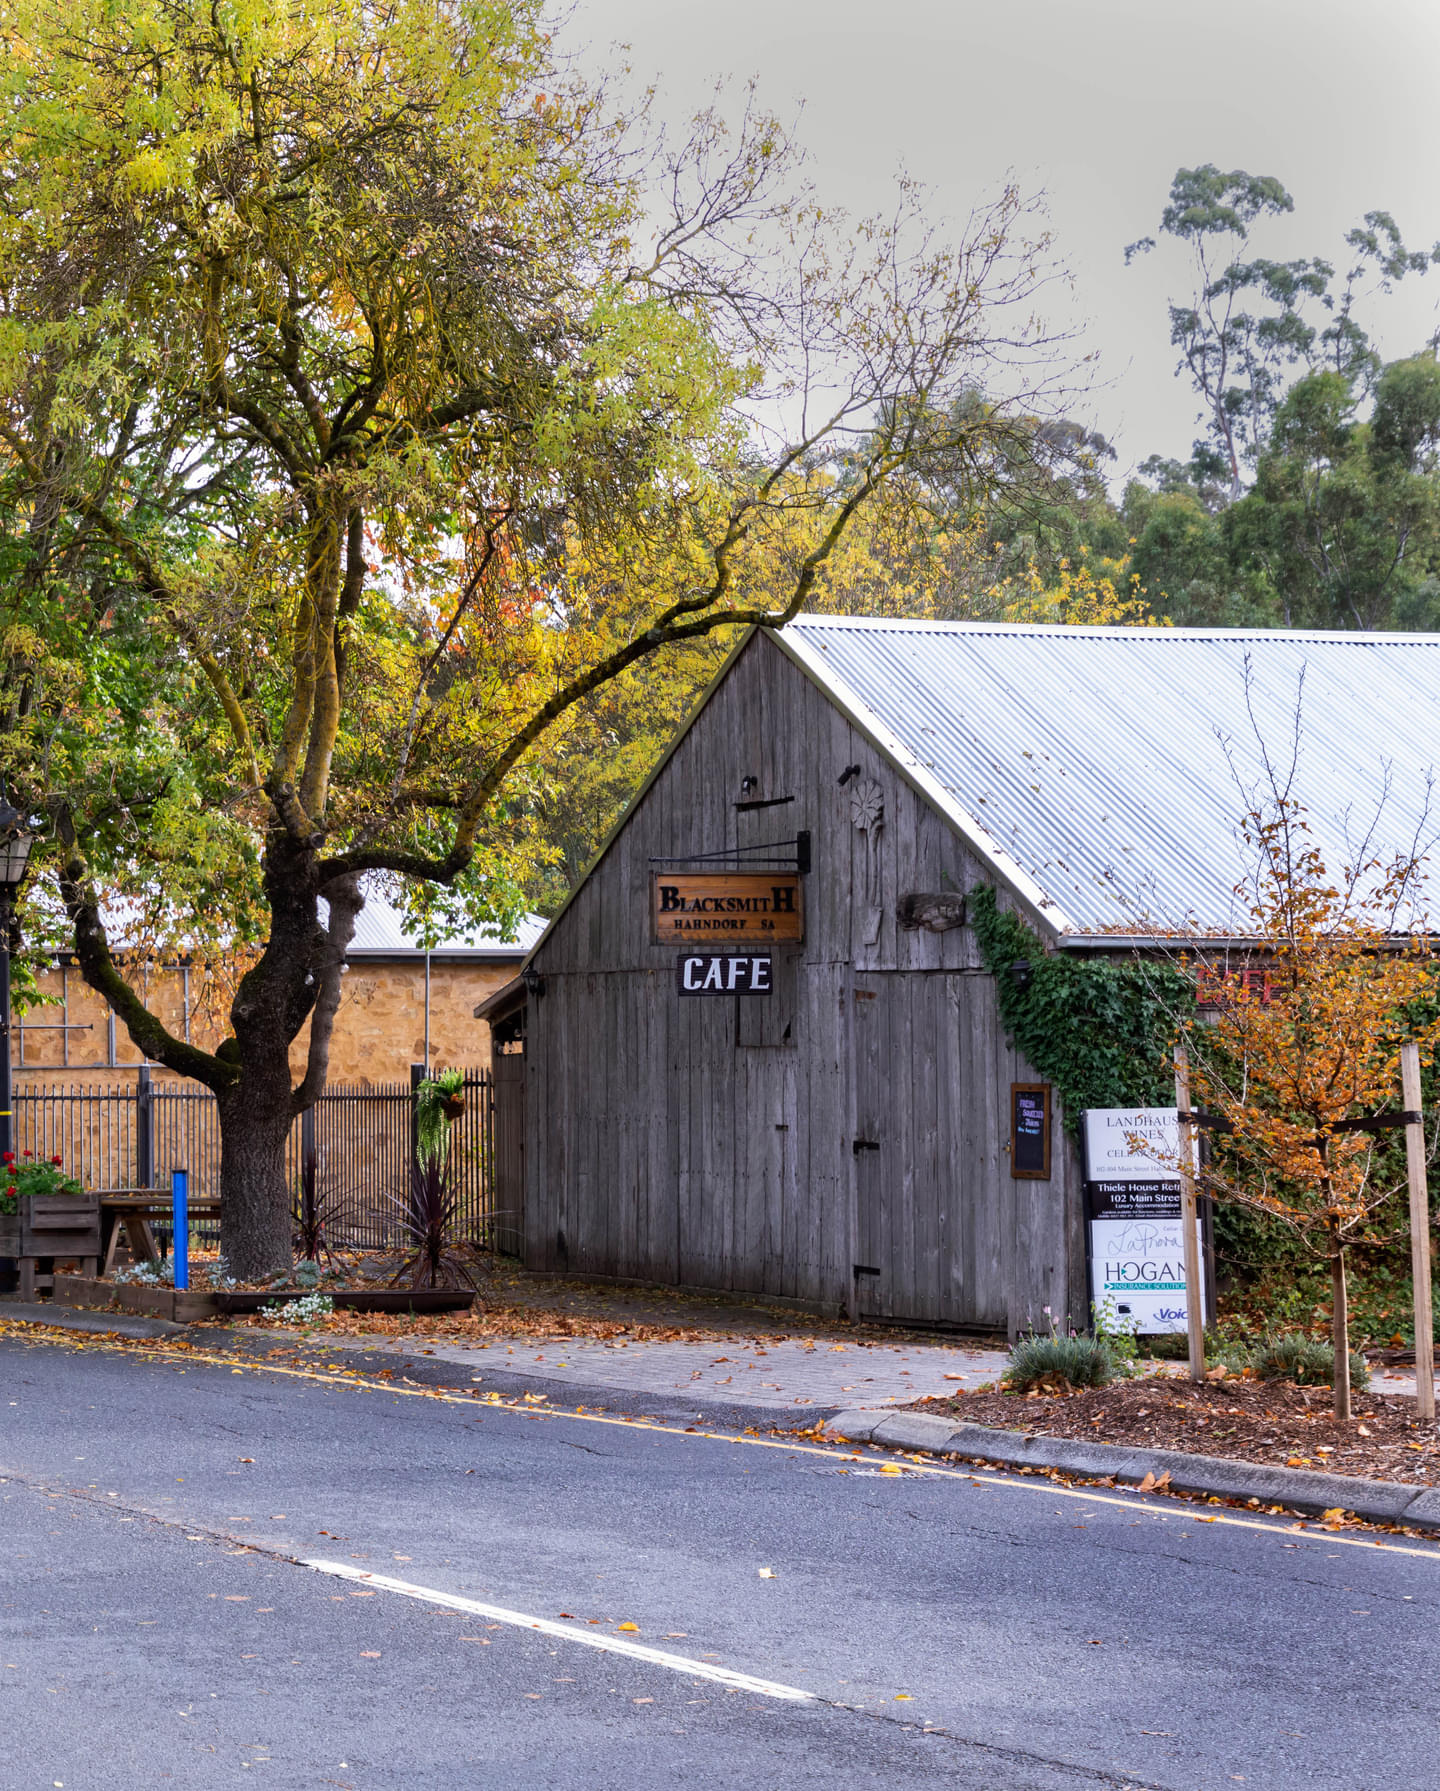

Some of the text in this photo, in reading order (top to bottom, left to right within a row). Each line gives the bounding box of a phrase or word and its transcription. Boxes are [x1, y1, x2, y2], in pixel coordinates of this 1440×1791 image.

[660, 886, 796, 912] BLACKSMITH
[674, 919, 775, 930] HAHNDORF SA
[683, 957, 771, 990] CAFE
[1107, 1116, 1178, 1127] LANDHAUS
[1122, 1130, 1164, 1140] WINES
[1098, 1183, 1126, 1192] Thiele
[1128, 1183, 1159, 1192] House
[1111, 1194, 1127, 1202] 102
[1129, 1193, 1153, 1202] Main
[1105, 1261, 1185, 1281] HOGAN
